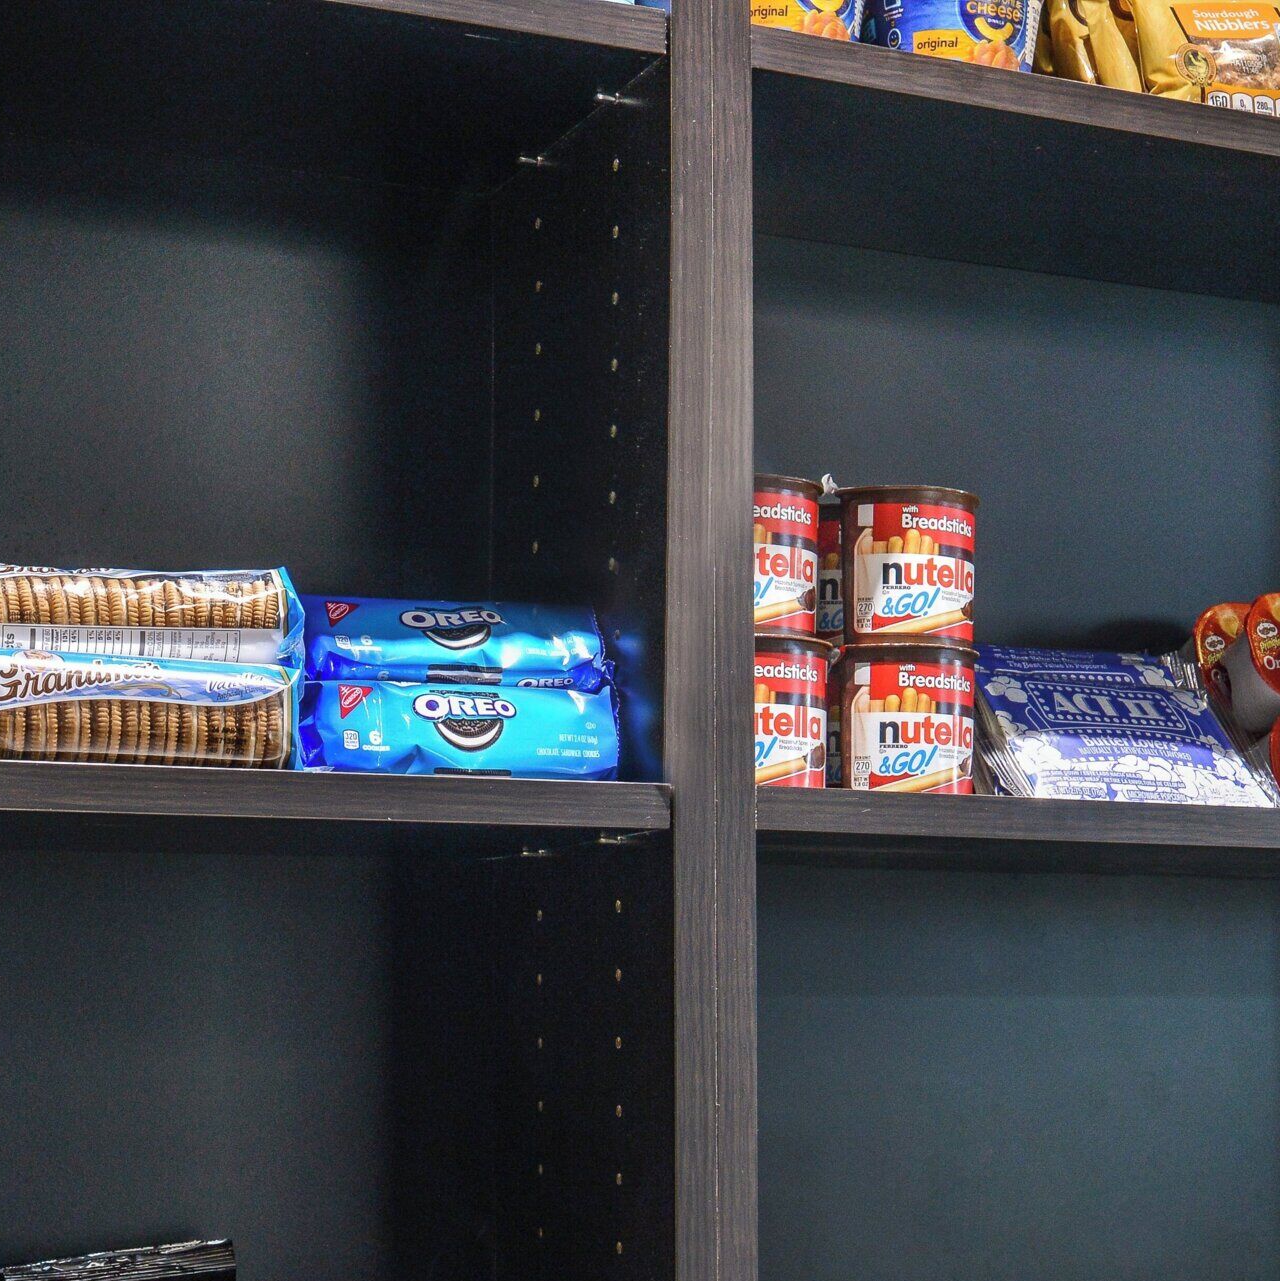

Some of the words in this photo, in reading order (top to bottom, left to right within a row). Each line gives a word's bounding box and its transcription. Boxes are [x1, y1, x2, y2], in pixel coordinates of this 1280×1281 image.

[1192, 8, 1259, 19] Sourdough
[1194, 19, 1270, 31] Nibblers
[917, 37, 958, 51] original
[901, 514, 972, 537] Breadsticks
[882, 556, 974, 594] nutella
[882, 587, 940, 616] &GO!
[399, 609, 502, 630] OREO
[898, 672, 970, 692] Breadsticks
[414, 693, 516, 720] OREO
[1053, 692, 1119, 716] ACT
[879, 715, 972, 749] nutella
[1082, 735, 1129, 747] Butter
[1131, 736, 1178, 751] Lovers
[879, 745, 938, 775] &GO!
